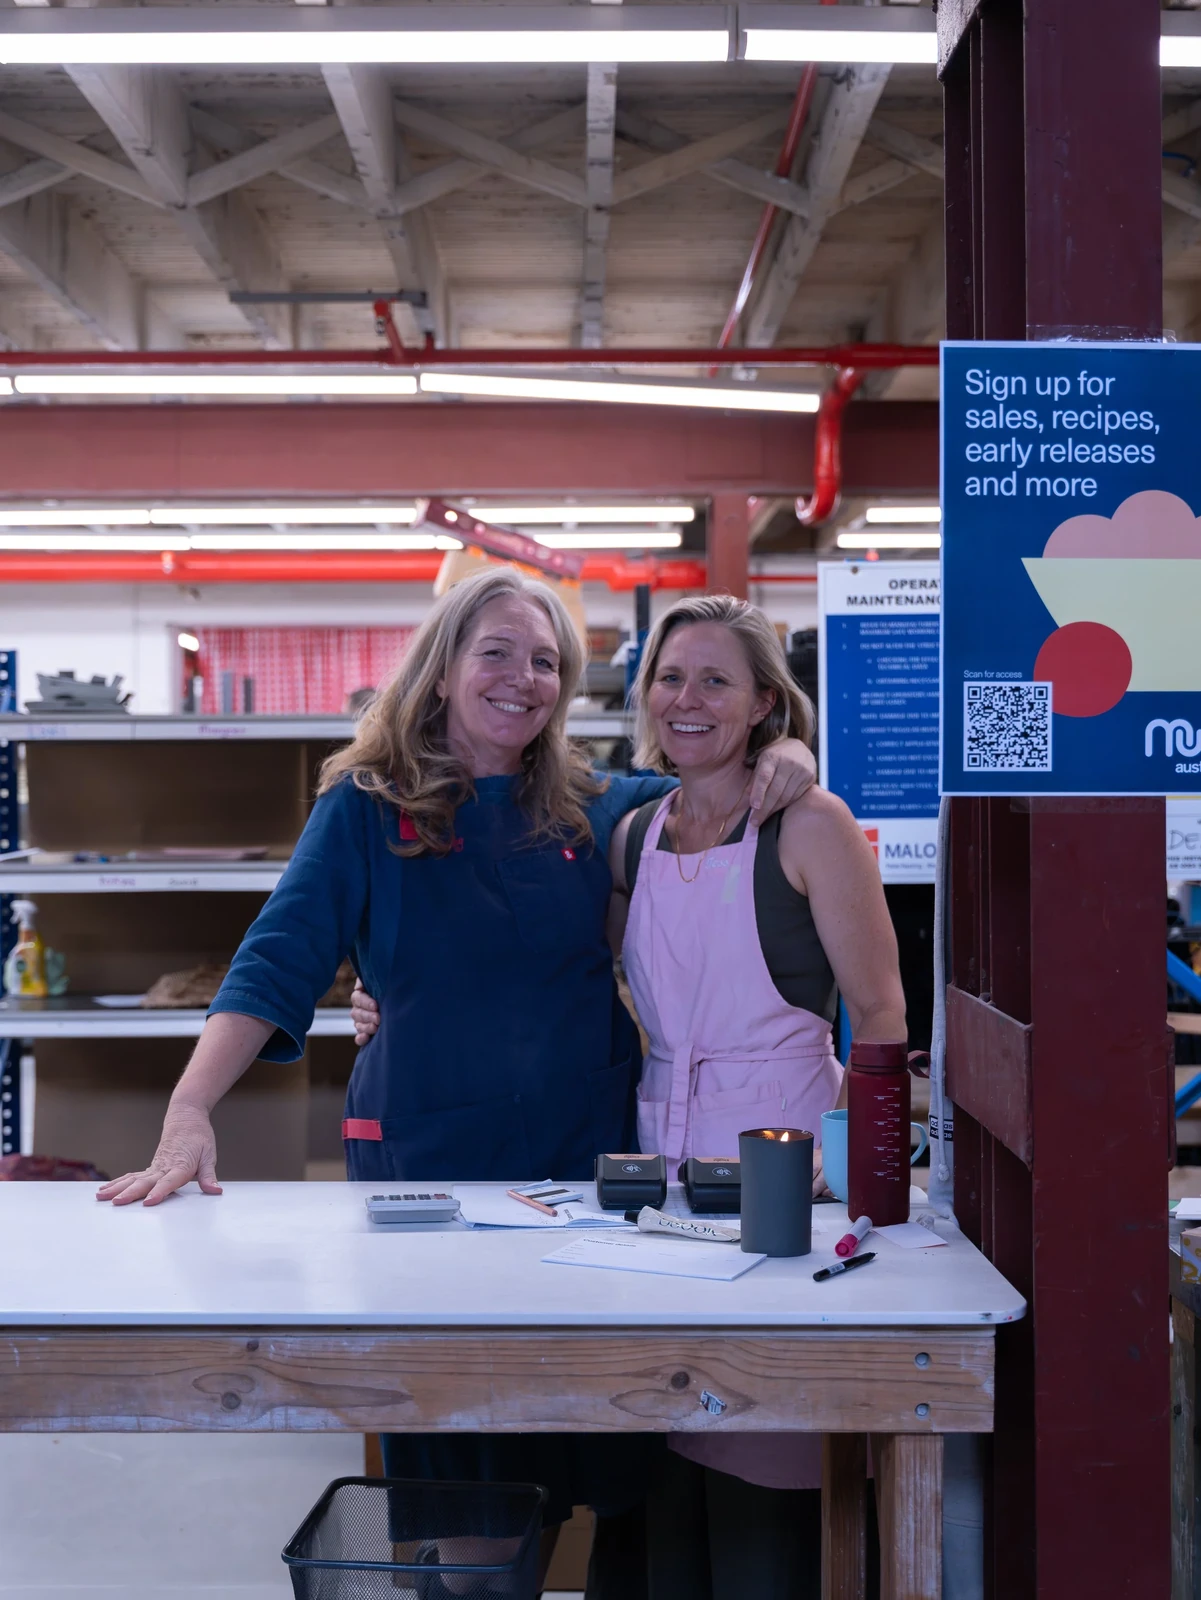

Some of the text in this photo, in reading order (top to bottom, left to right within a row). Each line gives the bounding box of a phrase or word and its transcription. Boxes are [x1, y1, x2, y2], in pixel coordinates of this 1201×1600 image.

[965, 369, 1116, 401] Sign up for
[965, 404, 1160, 435] sales, recipes,
[965, 437, 1156, 468] early releases
[965, 471, 1098, 497] and more
[888, 579, 940, 590] OPERA
[963, 669, 1023, 679] Scan for access
